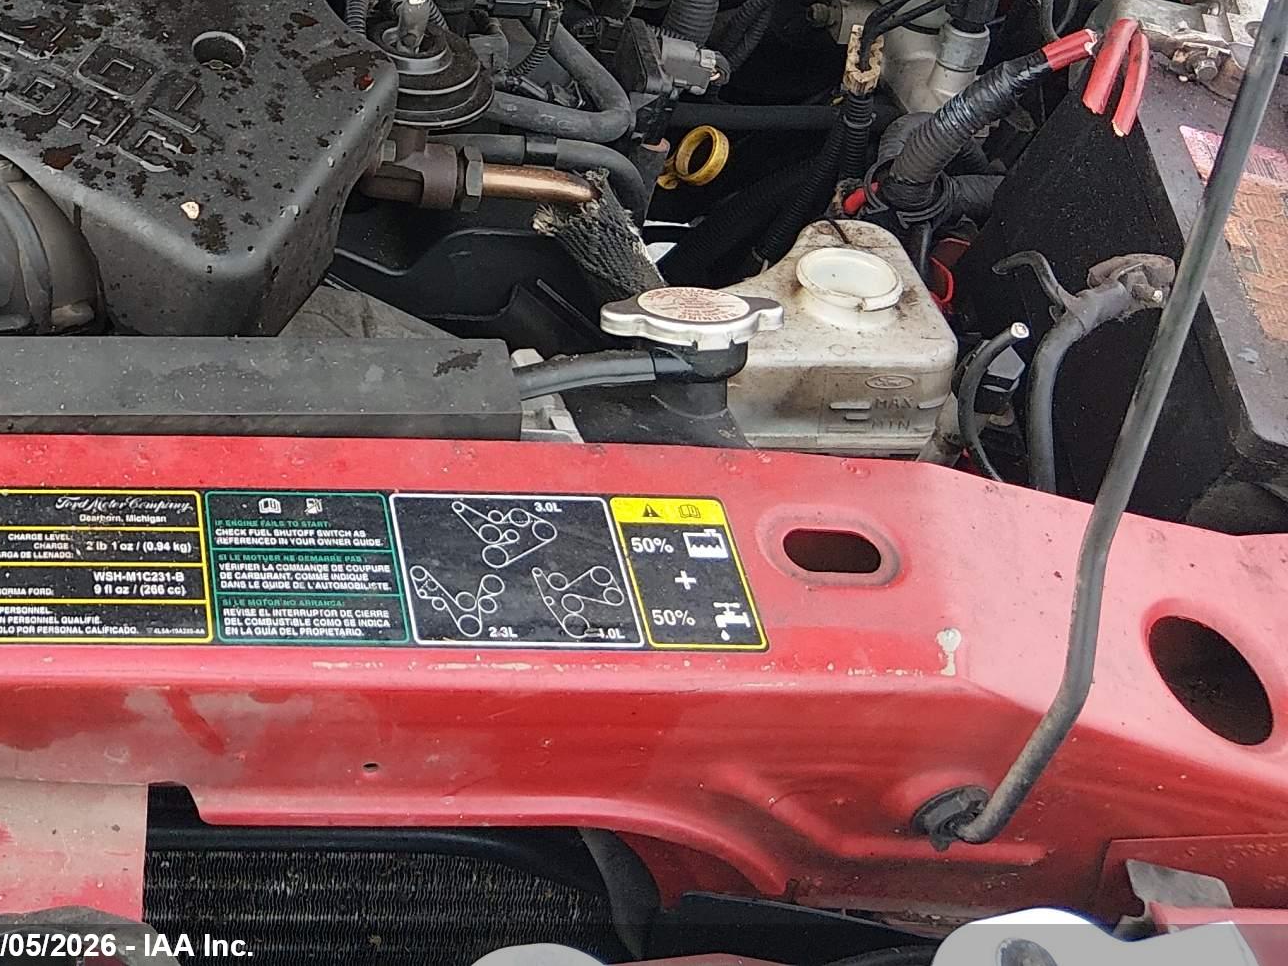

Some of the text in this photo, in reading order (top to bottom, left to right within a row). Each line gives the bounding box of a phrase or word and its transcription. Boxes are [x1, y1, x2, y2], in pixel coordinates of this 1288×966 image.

[874, 397, 913, 409] MAX
[872, 419, 911, 431] MIN
[56, 497, 193, 513] Ford Motor Company
[534, 502, 562, 513] 3.0L
[126, 515, 167, 523] Michigan
[215, 537, 277, 545] REFERENCED
[631, 536, 674, 553] 50%
[86, 541, 93, 550] 2
[96, 541, 107, 550] lb
[112, 541, 117, 550] 1
[142, 542, 171, 553] (0.94
[173, 542, 191, 553] kg)
[276, 564, 329, 572] COMMANDE
[93, 571, 185, 582] WSH-M1C231-B
[93, 584, 165, 596] 9 fl oz (266
[262, 581, 291, 589] GUIDE
[223, 608, 257, 616] REVISE
[273, 609, 337, 617] INTERRUPTOR
[340, 610, 352, 618] DE
[354, 610, 389, 618] CIERRE
[651, 609, 696, 626] 50%
[7, 616, 60, 624] PERSONNEL
[244, 618, 311, 626] COMBUSTIBLE
[313, 618, 342, 626] COMO
[358, 619, 390, 627] INDICA
[16, 626, 35, 634] POR
[37, 626, 83, 634] PERSONAL
[225, 627, 238, 635] EN
[240, 627, 252, 635] LA
[300, 628, 364, 636] PROPIETARIO.
[488, 626, 518, 638] 2.3L
